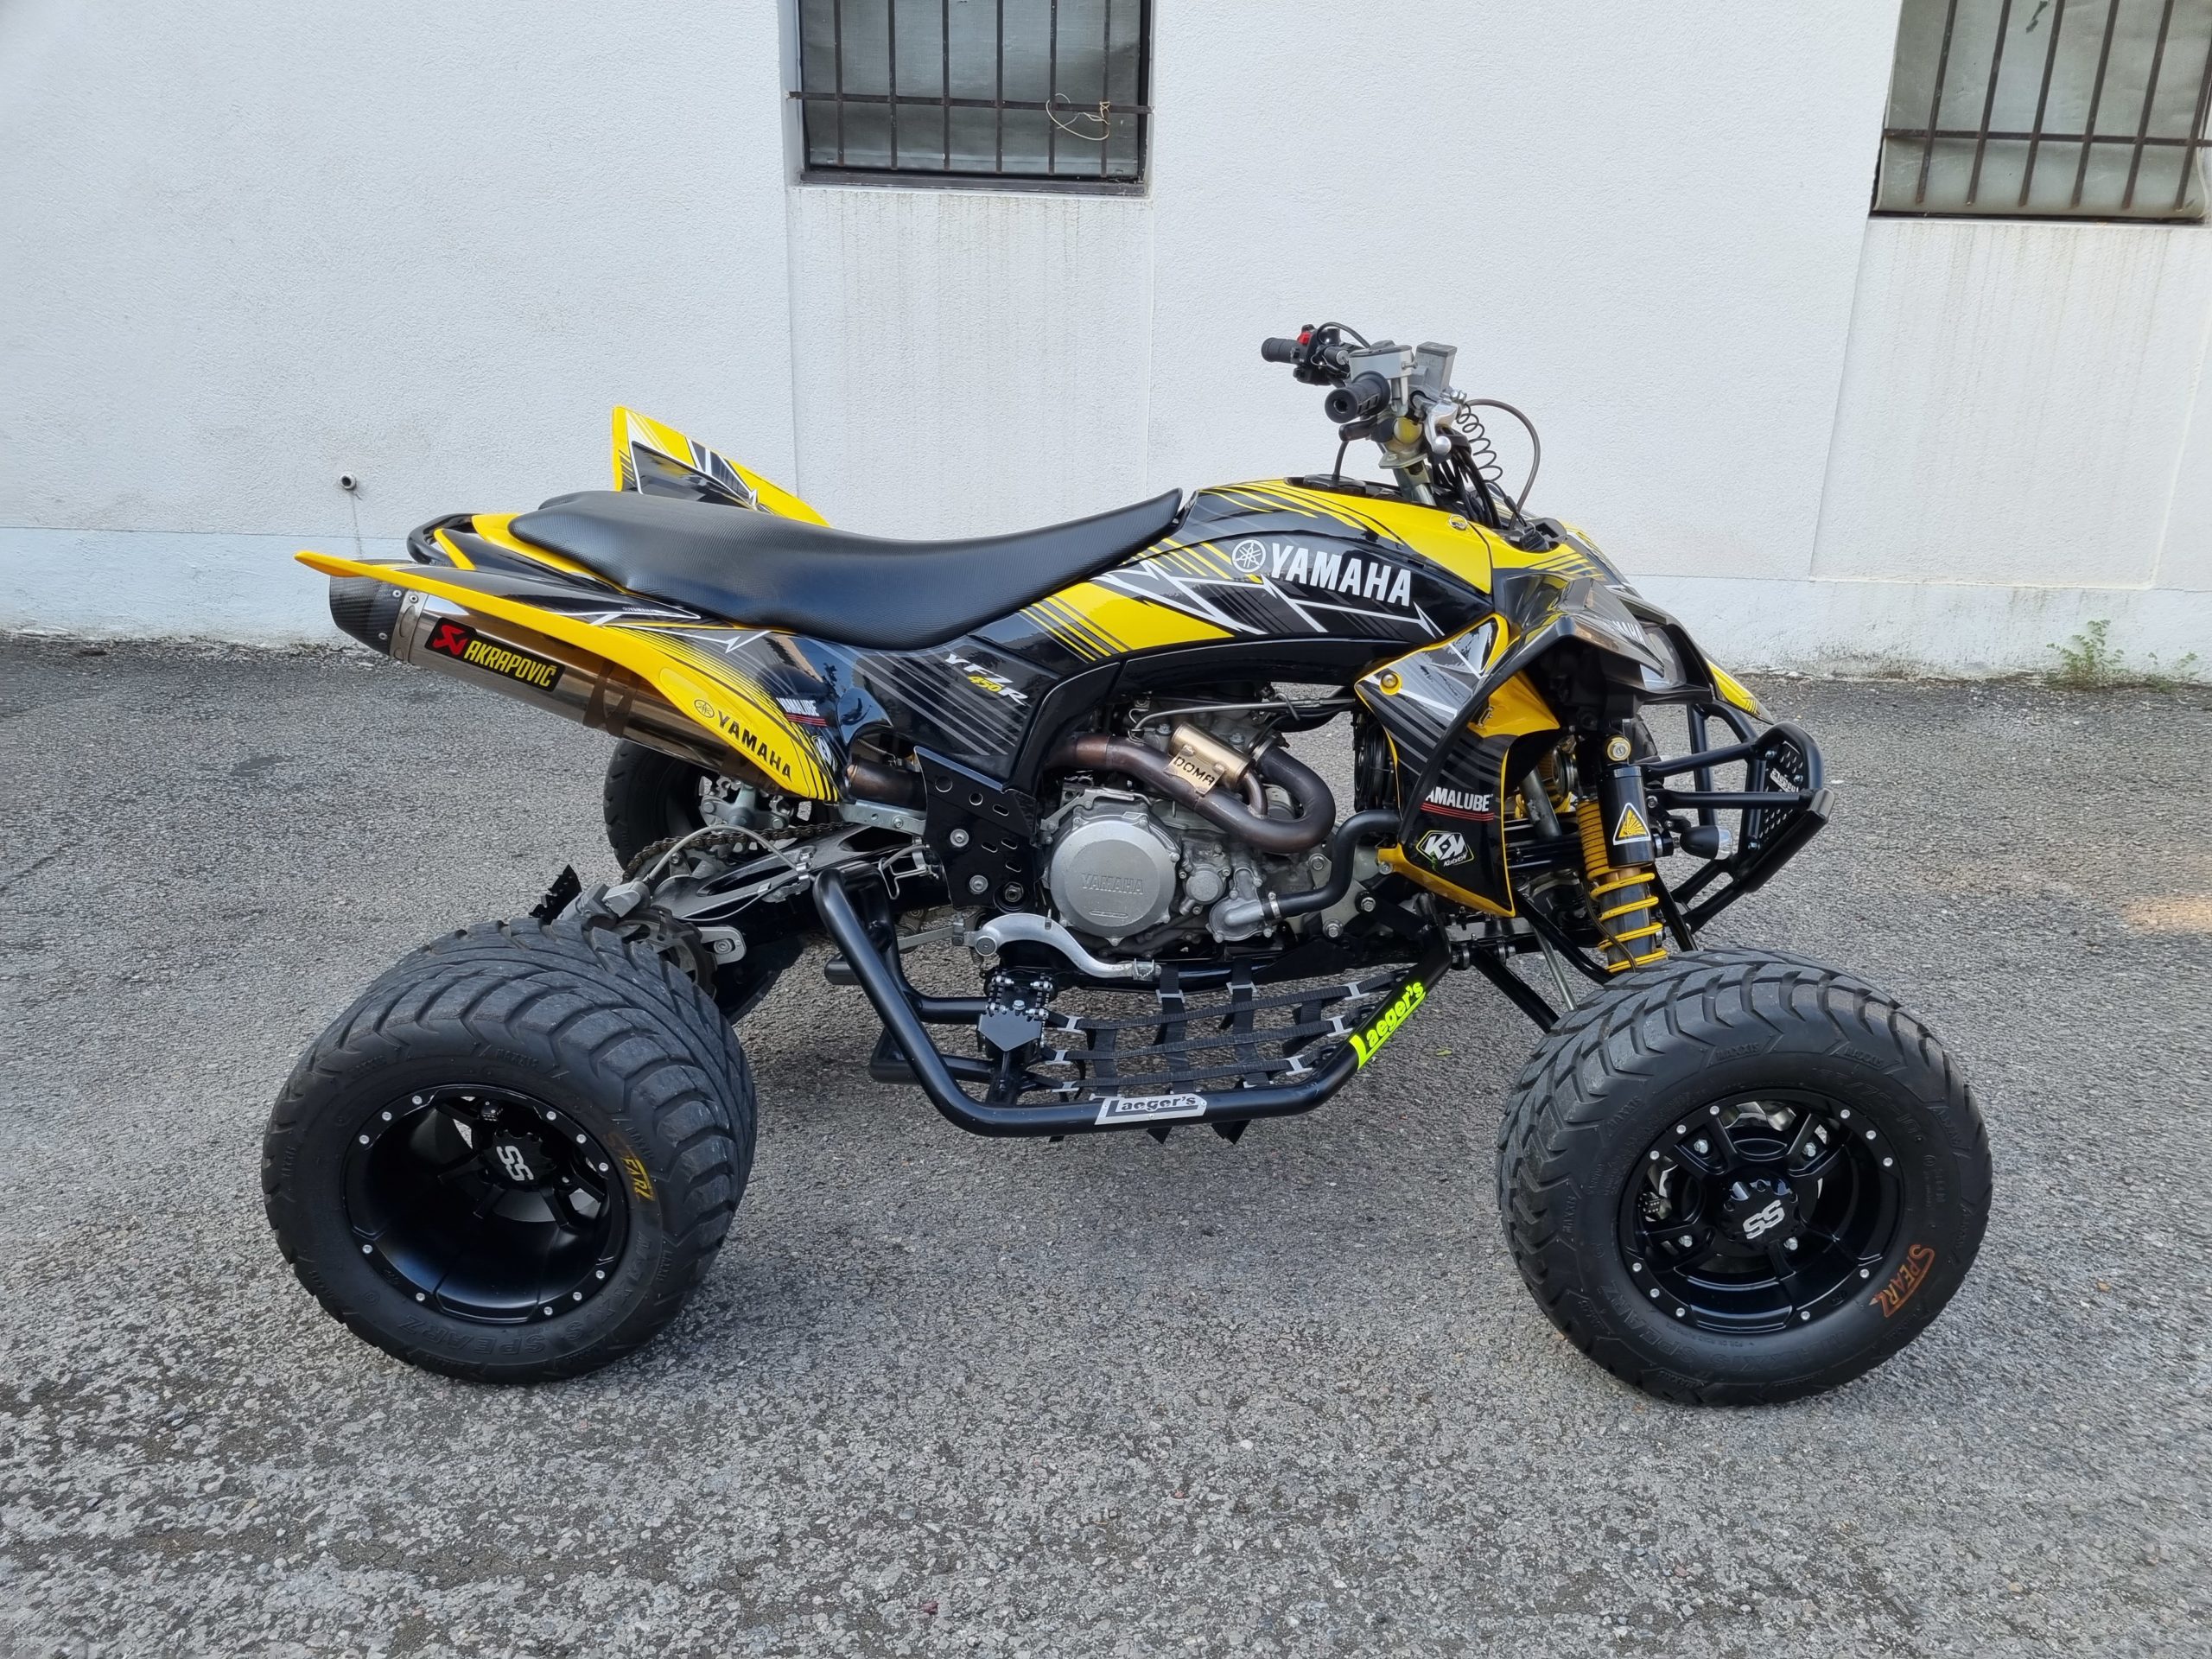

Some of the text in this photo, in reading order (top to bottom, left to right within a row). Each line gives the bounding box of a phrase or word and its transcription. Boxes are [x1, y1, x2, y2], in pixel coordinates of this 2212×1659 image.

[1271, 543, 1412, 607] YAMAHA
[717, 709, 792, 783] YAMAHA
[1173, 756, 1216, 786] DOMA
[1425, 786, 1490, 812] AMALUBE
[1080, 873, 1144, 895] YAMAHA
[1349, 982, 1427, 1071] Laeger's
[1106, 1096, 1199, 1118] Laeger's
[496, 1145, 534, 1181] SS
[1742, 1199, 1785, 1239] SS
[1868, 1243, 1936, 1319] SPEARZ
